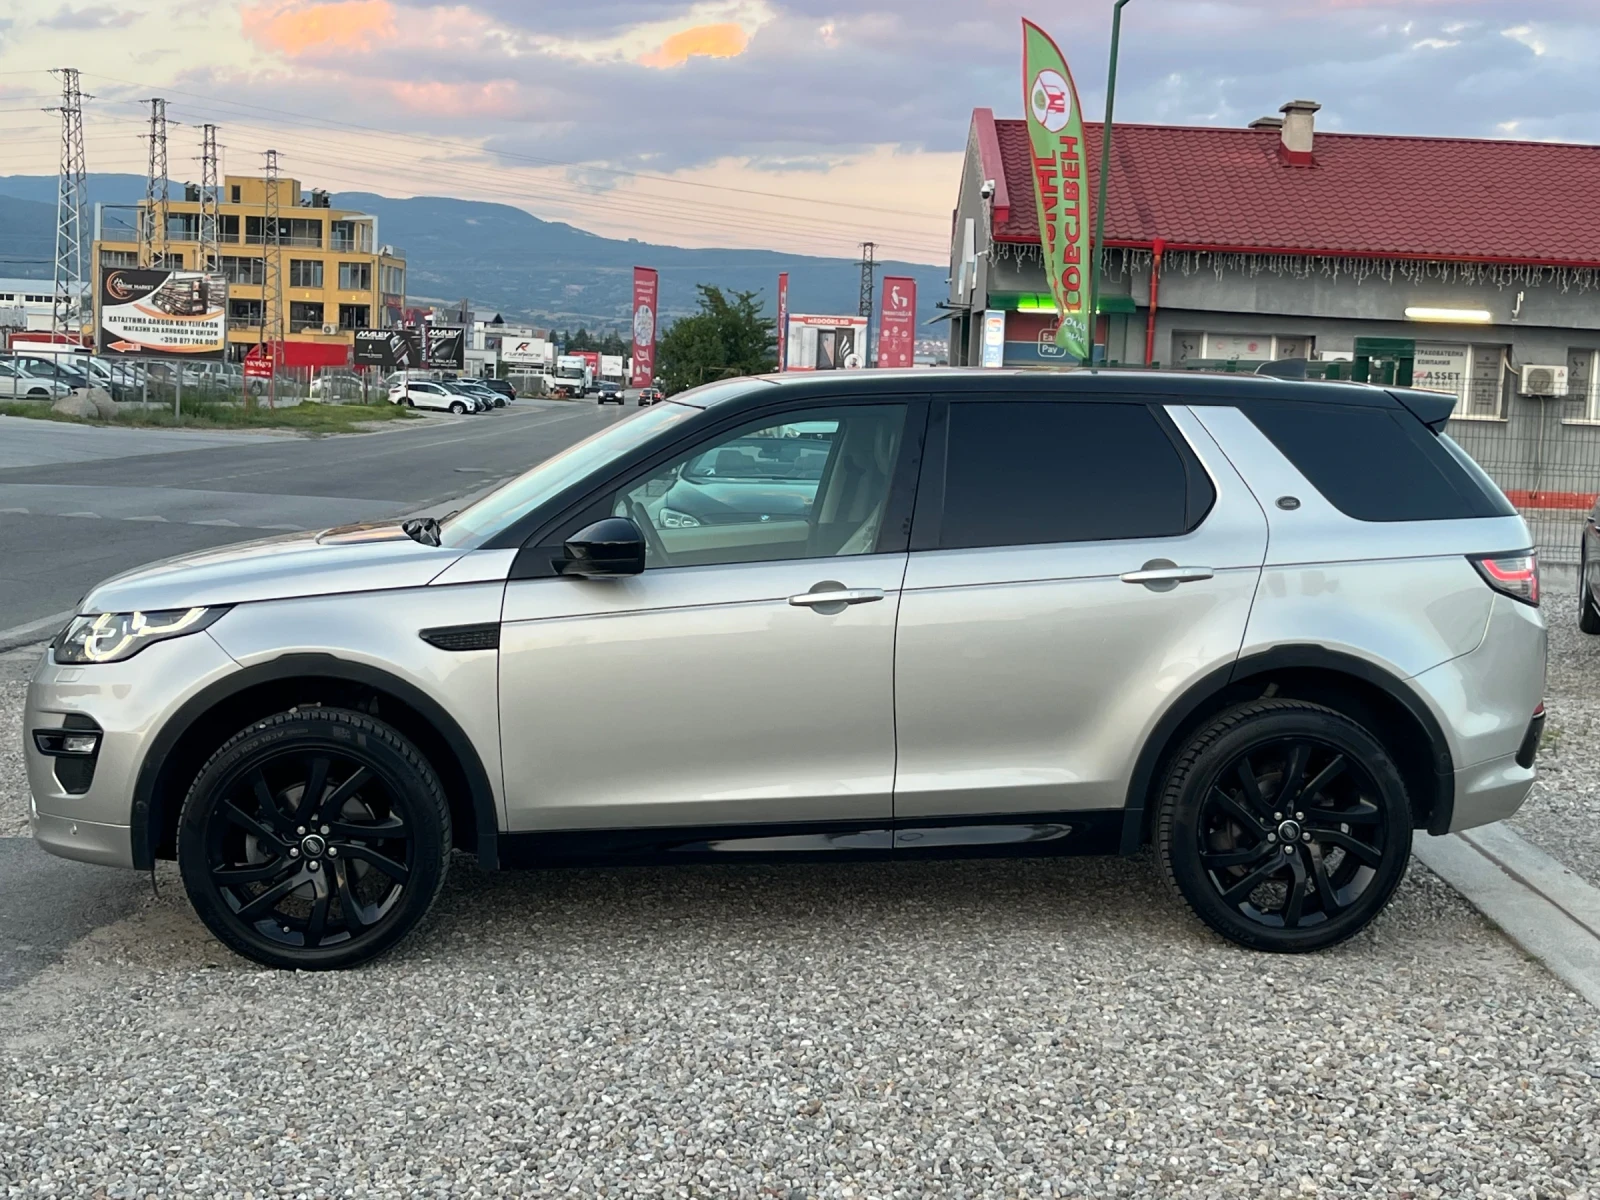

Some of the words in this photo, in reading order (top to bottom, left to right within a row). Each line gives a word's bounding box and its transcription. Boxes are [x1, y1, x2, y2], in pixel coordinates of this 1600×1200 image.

[195, 329, 218, 337] ЦИГАРИ
[1043, 333, 1056, 341] Ea
[1042, 345, 1058, 354] Pay
[1425, 371, 1460, 380] ASSET
